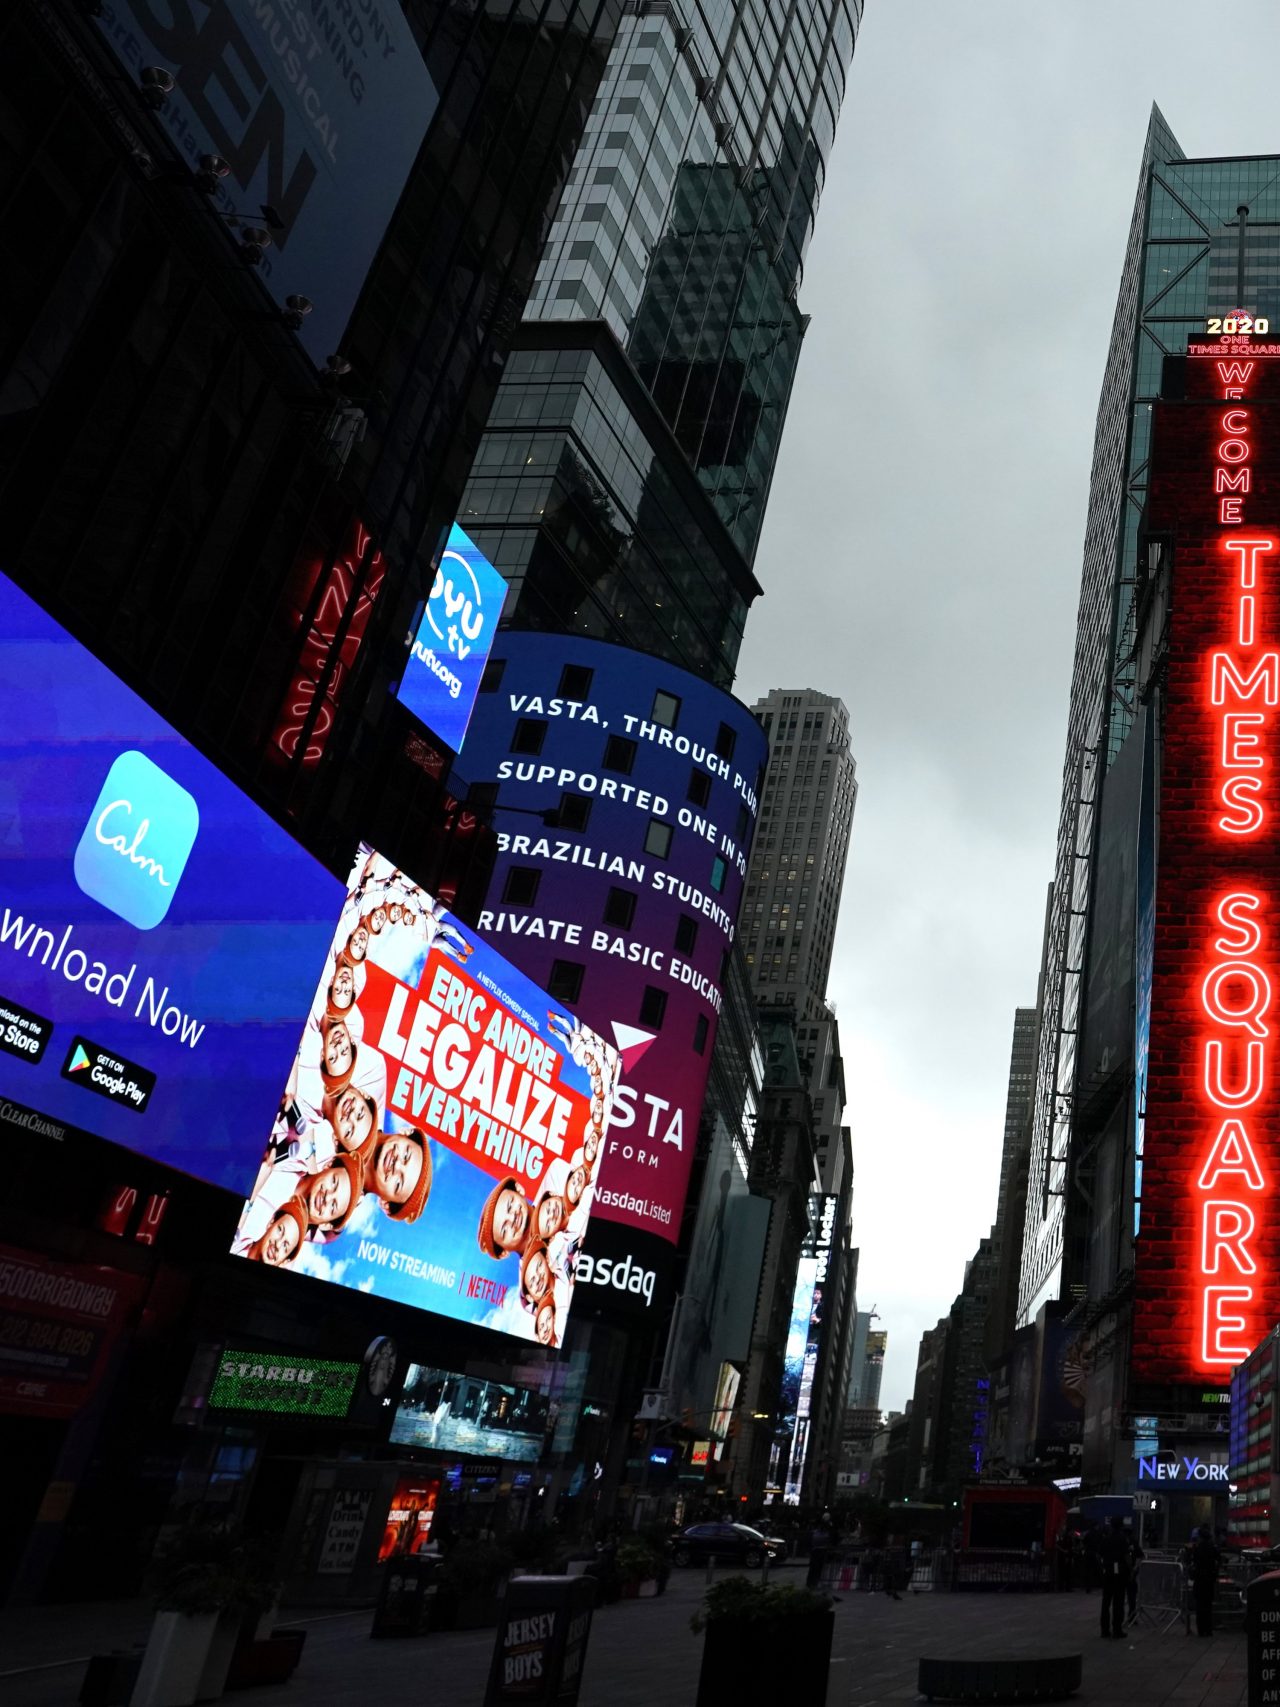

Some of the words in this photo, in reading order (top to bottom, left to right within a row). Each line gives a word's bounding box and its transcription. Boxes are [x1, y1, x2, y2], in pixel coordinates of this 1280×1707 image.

[1207, 319, 1269, 334] 2020
[1220, 335, 1249, 344] ONE
[1189, 345, 1229, 354] TIMES
[1216, 362, 1254, 523] WECOME
[448, 624, 471, 661] tv
[1211, 540, 1279, 834] TIMES
[509, 694, 609, 728] VASTA,
[624, 714, 731, 781] THROUGH
[497, 760, 669, 817] SUPPORTED
[677, 808, 718, 844] ONE
[721, 834, 736, 858] IN
[737, 853, 748, 878] FO
[95, 800, 172, 887] Calm
[496, 832, 646, 883] BRAZILIAN
[651, 871, 731, 935] STUDENTS
[591, 930, 665, 971] BASIC
[669, 958, 723, 1016] EDUCATI
[135, 977, 206, 1049] Now
[428, 964, 487, 1033] ERIC
[482, 1008, 557, 1084] ANDRE
[481, 975, 503, 998] NETFLIX
[501, 993, 522, 1014] COMEDY
[521, 1010, 540, 1031] SPECIAL
[4, 1025, 40, 1054] Store
[19, 1018, 29, 1028] on
[29, 1023, 42, 1035] the
[91, 1065, 126, 1094] Google
[125, 1081, 146, 1105] Play
[97, 1054, 109, 1066] GET
[108, 1059, 115, 1068] IT
[114, 1062, 125, 1073] ON
[377, 982, 573, 1157] LEGALIZE
[391, 1066, 544, 1180] EVERYTHING
[1198, 892, 1271, 1364] SQUARE
[608, 1141, 660, 1169] FORM
[816, 1196, 837, 1247] Locker
[357, 1240, 391, 1267] NOW
[389, 1251, 456, 1289] STREAMING
[575, 1253, 657, 1307] asdaq
[467, 1274, 509, 1307] NETFLIX
[221, 1361, 353, 1387] STARBUCKS
[239, 1383, 323, 1404] COFFEE
[504, 1611, 557, 1648] JERSEY
[1261, 1630, 1276, 1643] BE
[504, 1650, 543, 1685] BOYS
[1262, 1668, 1277, 1681] OF
